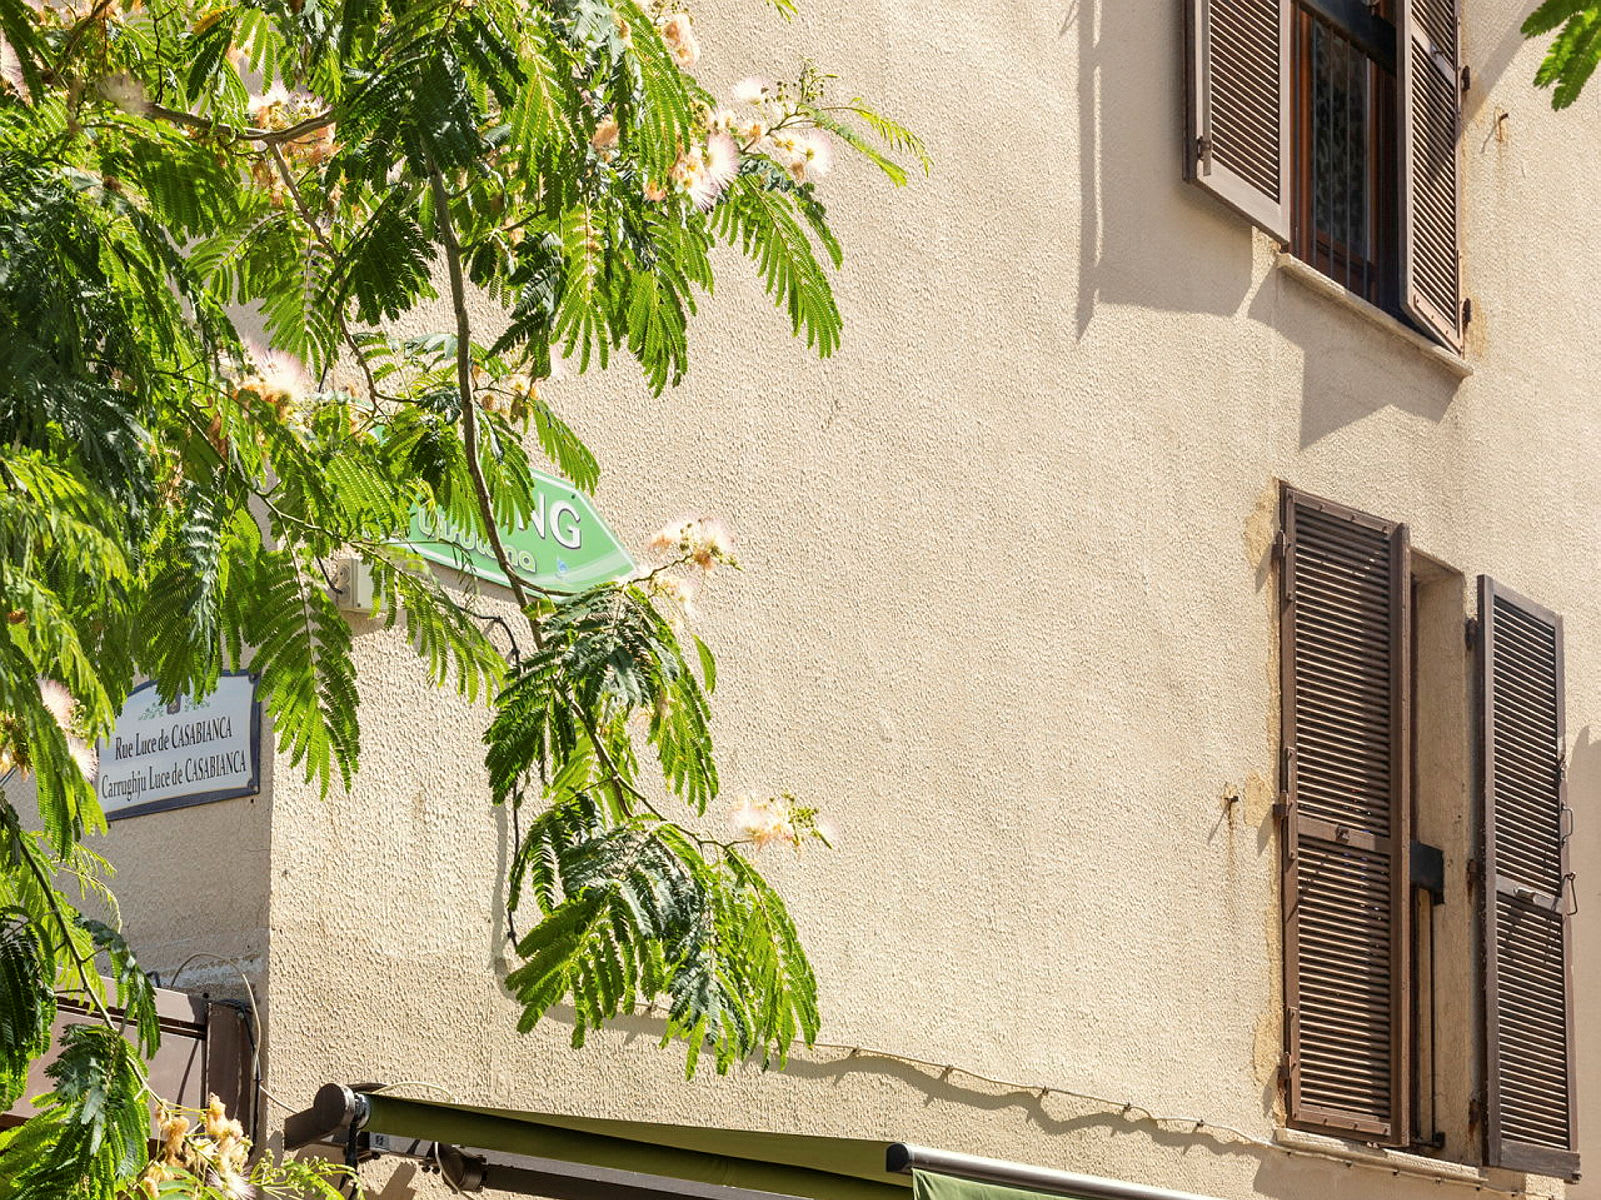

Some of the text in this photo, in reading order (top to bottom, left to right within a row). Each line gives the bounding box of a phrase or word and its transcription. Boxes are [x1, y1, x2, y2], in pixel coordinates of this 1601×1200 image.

[115, 716, 233, 760] Rue Luce de CASABIANCA
[101, 750, 246, 802] Carrughju Luce de CASABIANCA
